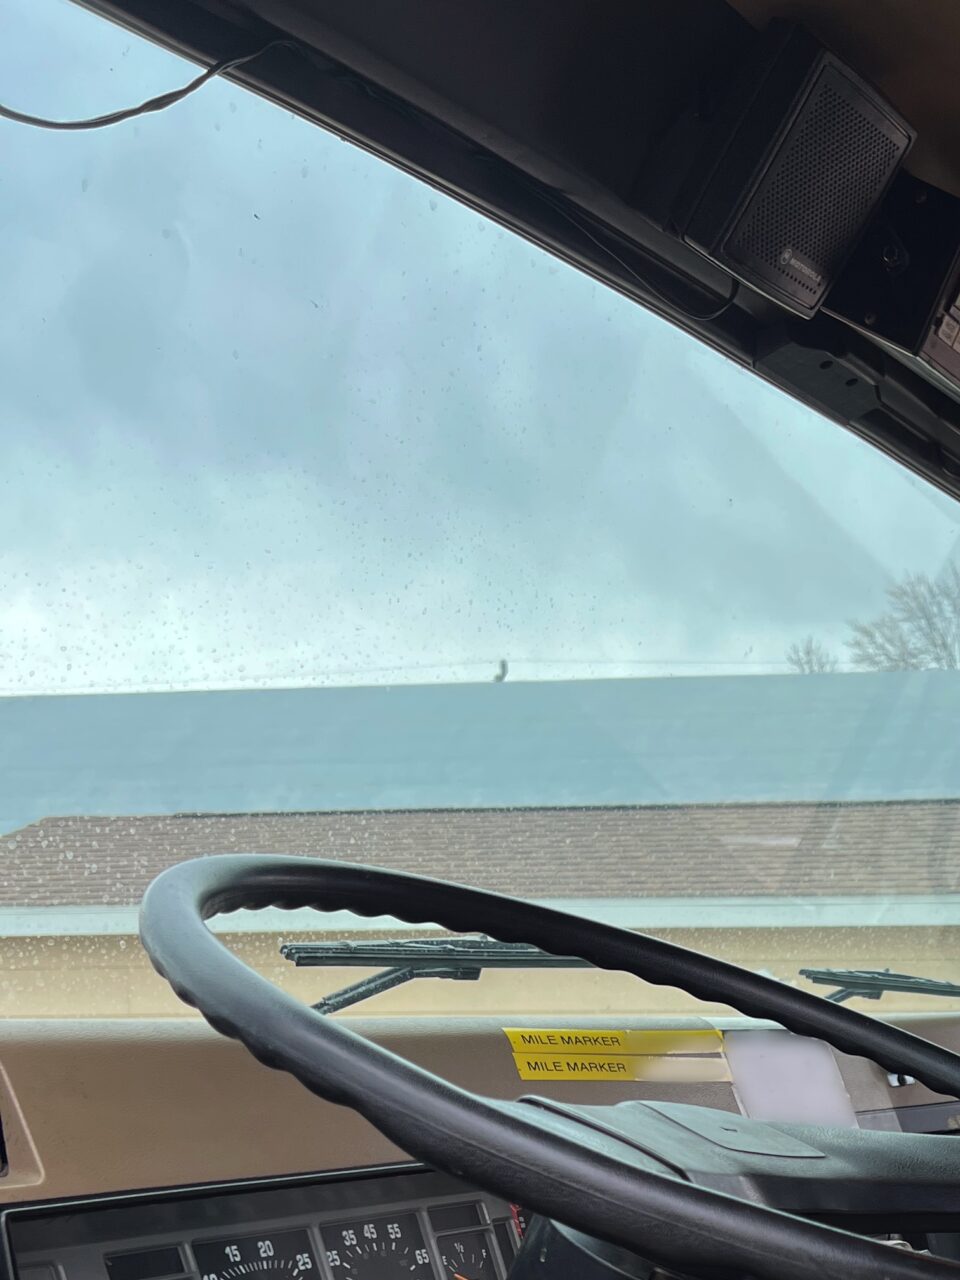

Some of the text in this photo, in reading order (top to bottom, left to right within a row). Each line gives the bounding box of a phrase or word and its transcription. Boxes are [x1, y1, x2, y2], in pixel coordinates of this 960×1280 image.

[521, 1034, 621, 1047] MILE MARKER
[527, 1061, 627, 1073] MILE MARKER
[342, 1230, 357, 1246] 35
[363, 1224, 378, 1239] 45
[387, 1224, 401, 1239] 55
[225, 1245, 241, 1263] 15
[257, 1240, 274, 1258] 20
[415, 1249, 430, 1265] 65
[296, 1253, 312, 1271] 25
[326, 1250, 341, 1267] 25
[441, 1256, 448, 1266] E
